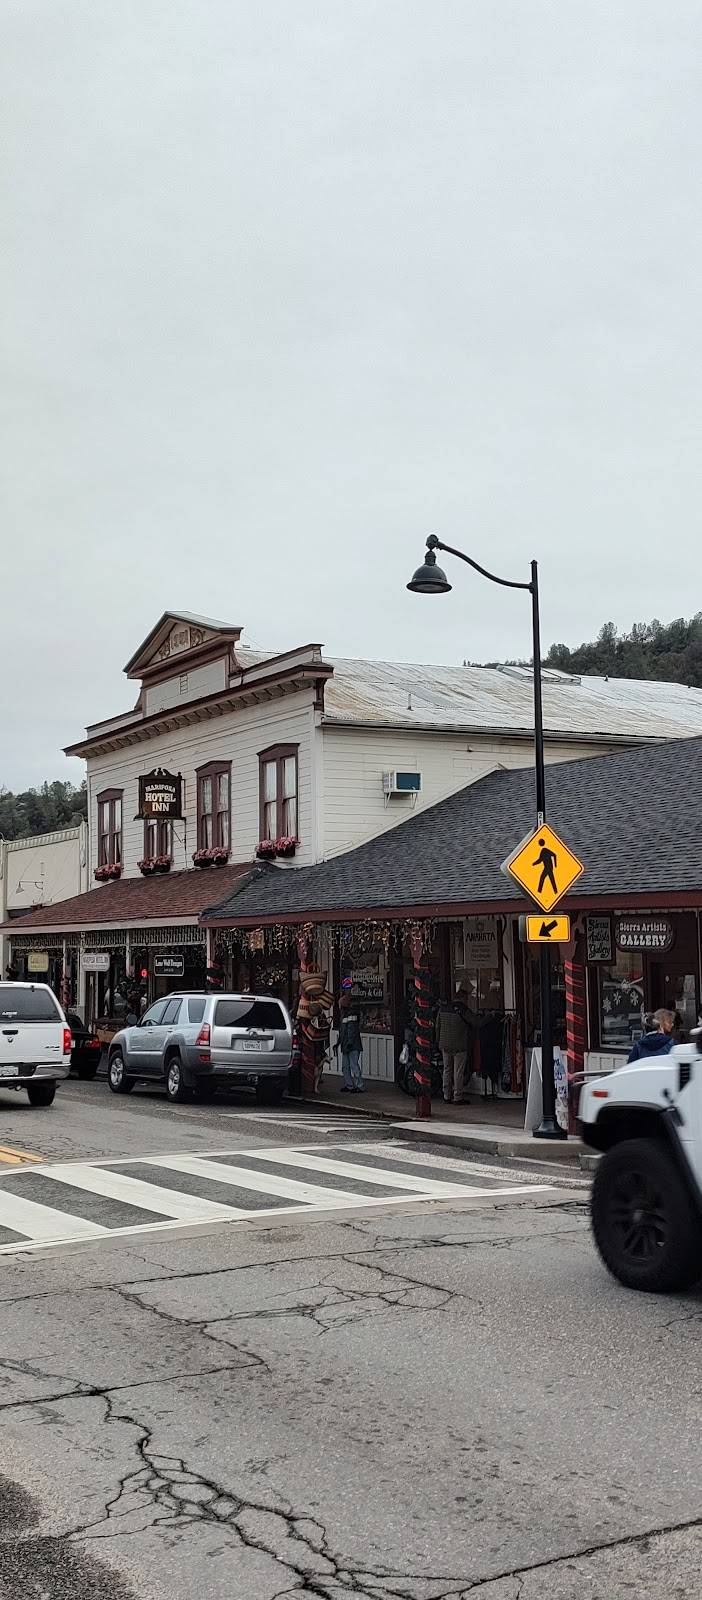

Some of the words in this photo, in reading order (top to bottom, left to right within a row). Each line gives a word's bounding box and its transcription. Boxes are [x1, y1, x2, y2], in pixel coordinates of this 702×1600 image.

[144, 783, 176, 793] MARIPOSA
[144, 792, 176, 802] HOTEL
[151, 802, 170, 812] INN
[619, 922, 641, 932] Sierra
[642, 922, 667, 932] Artists
[620, 934, 667, 946] GALLERY
